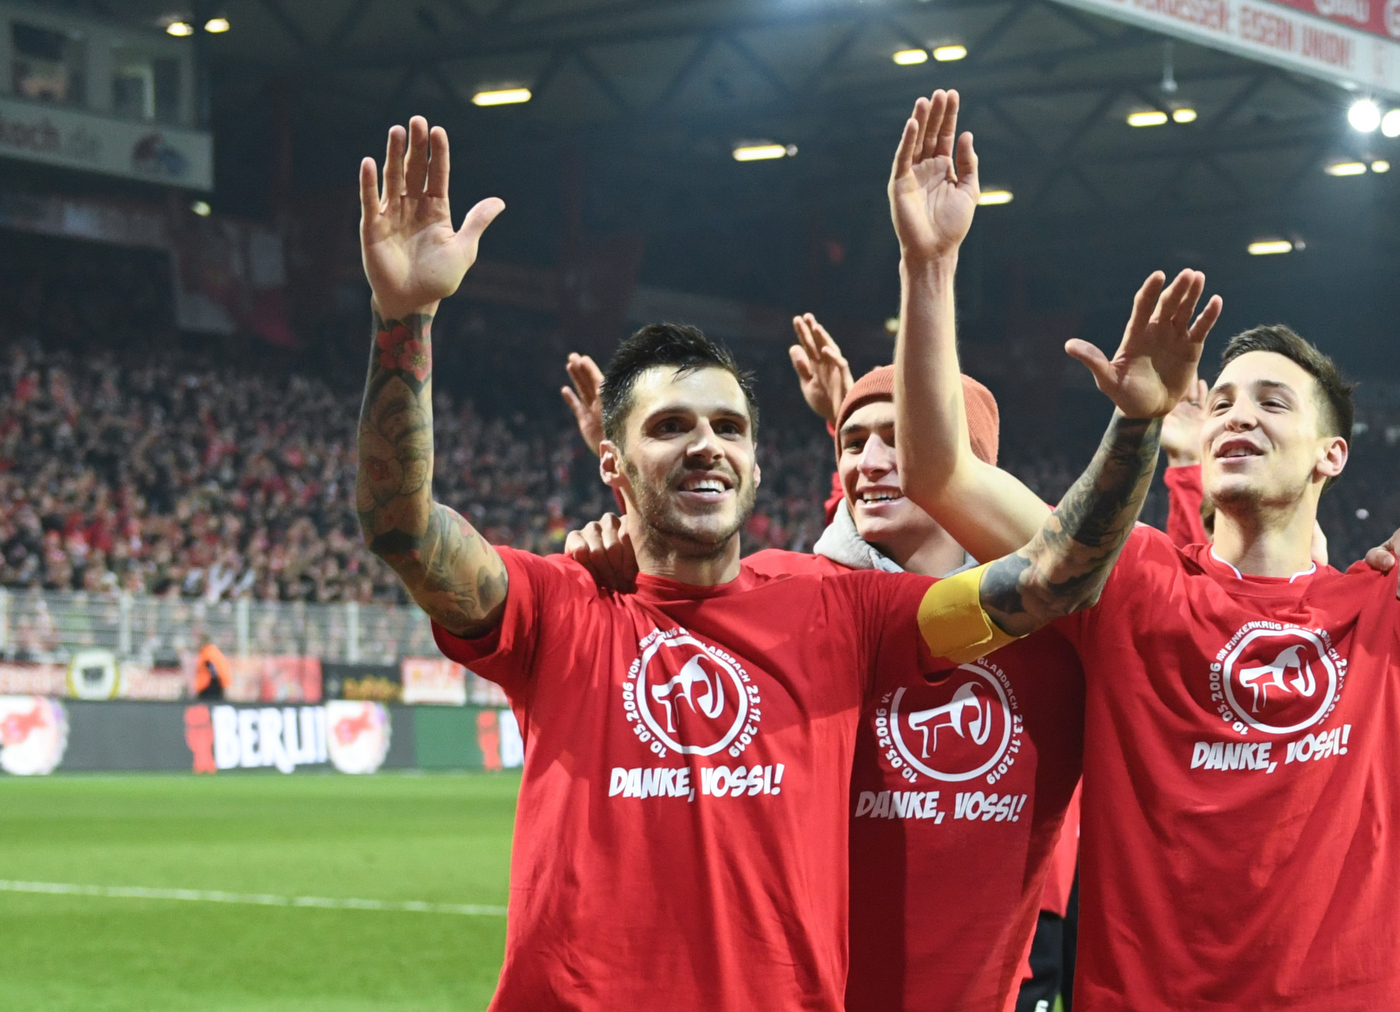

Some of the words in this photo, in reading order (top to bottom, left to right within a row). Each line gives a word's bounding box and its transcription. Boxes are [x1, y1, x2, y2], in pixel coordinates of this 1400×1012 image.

[1226, 620, 1283, 652] FINKENKRUG
[622, 681, 668, 759] 10.05.2006
[727, 684, 762, 758] 23.11.2019
[1208, 661, 1250, 736] 10.05.2006
[874, 707, 919, 784] 10.05.2006
[985, 714, 1024, 786] 23.11.2019
[1190, 740, 1279, 774] DANKE,
[1284, 723, 1352, 765] VOSSI!
[608, 766, 695, 803] DANKE,
[701, 762, 786, 798] VOSSI!
[854, 789, 946, 825] DANKE,
[953, 790, 1028, 823] VOSSI!
